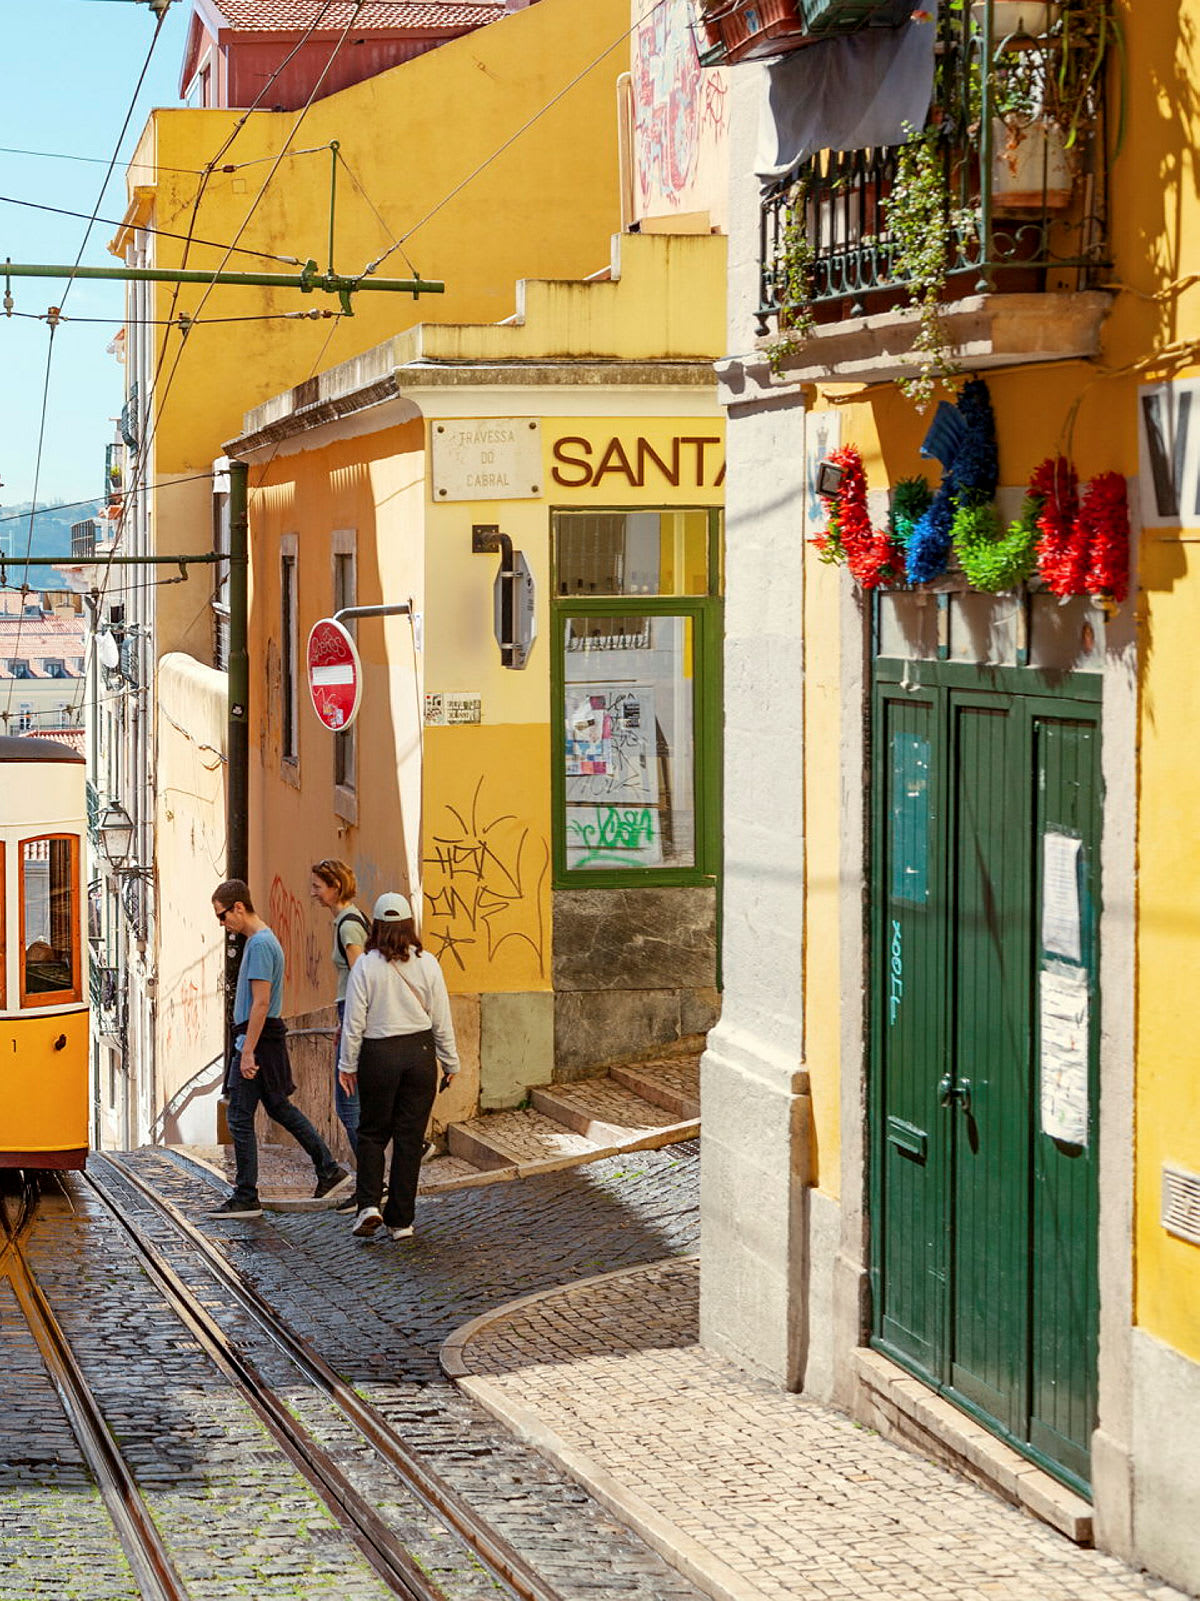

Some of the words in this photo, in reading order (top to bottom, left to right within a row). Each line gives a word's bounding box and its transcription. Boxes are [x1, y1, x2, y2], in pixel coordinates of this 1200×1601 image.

[459, 431, 515, 445] TRAVESSA
[480, 450, 495, 464] DO
[552, 436, 726, 487] SANT
[466, 472, 510, 487] CABRAL
